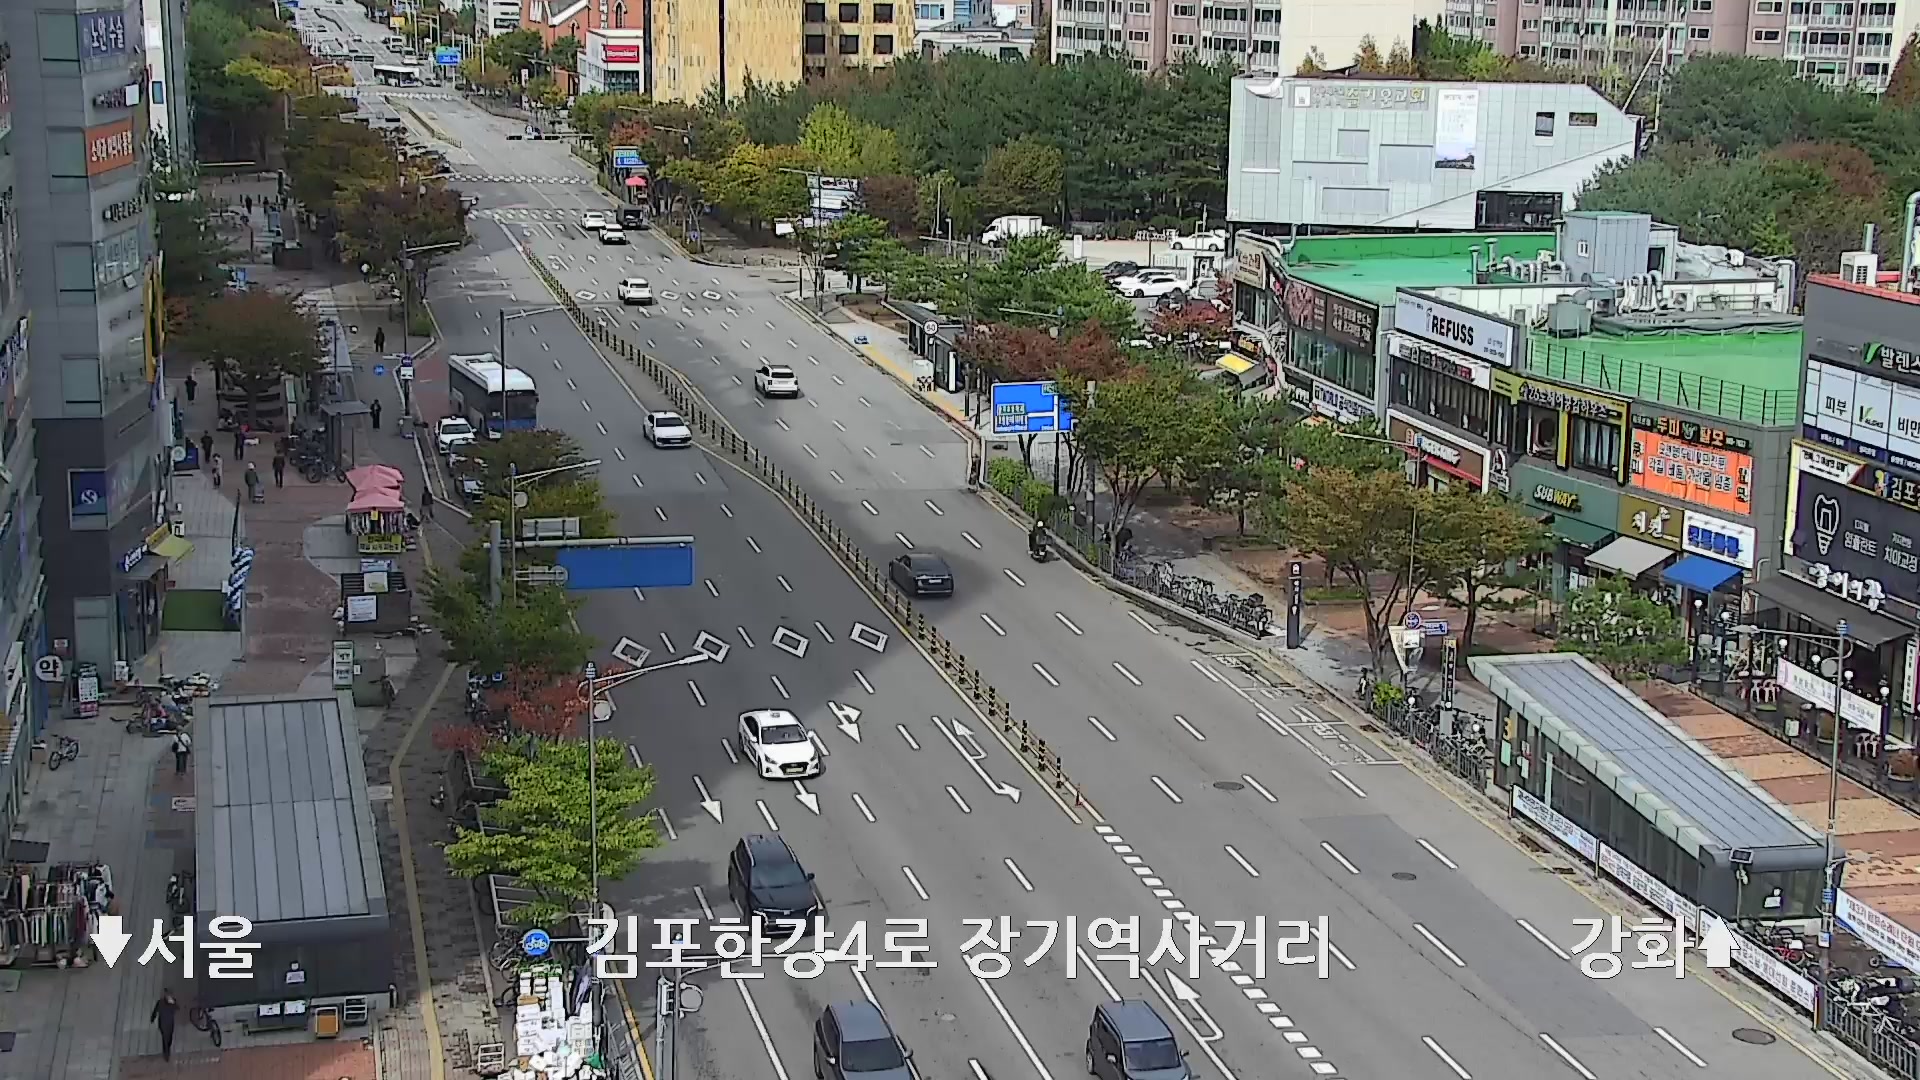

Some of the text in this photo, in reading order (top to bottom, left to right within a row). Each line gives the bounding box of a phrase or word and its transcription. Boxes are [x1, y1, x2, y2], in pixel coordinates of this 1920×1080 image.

[91, 16, 124, 51] 노안 수술
[1431, 314, 1474, 346] REFUSS
[1825, 395, 1848, 417] 피부
[1897, 416, 1920, 438] 비만
[1648, 456, 1665, 475] 각질
[1534, 484, 1576, 507] SUBWAY
[1844, 532, 1879, 558] 임플란트
[1883, 546, 1918, 573] 치아교정
[39, 658, 60, 678] 약
